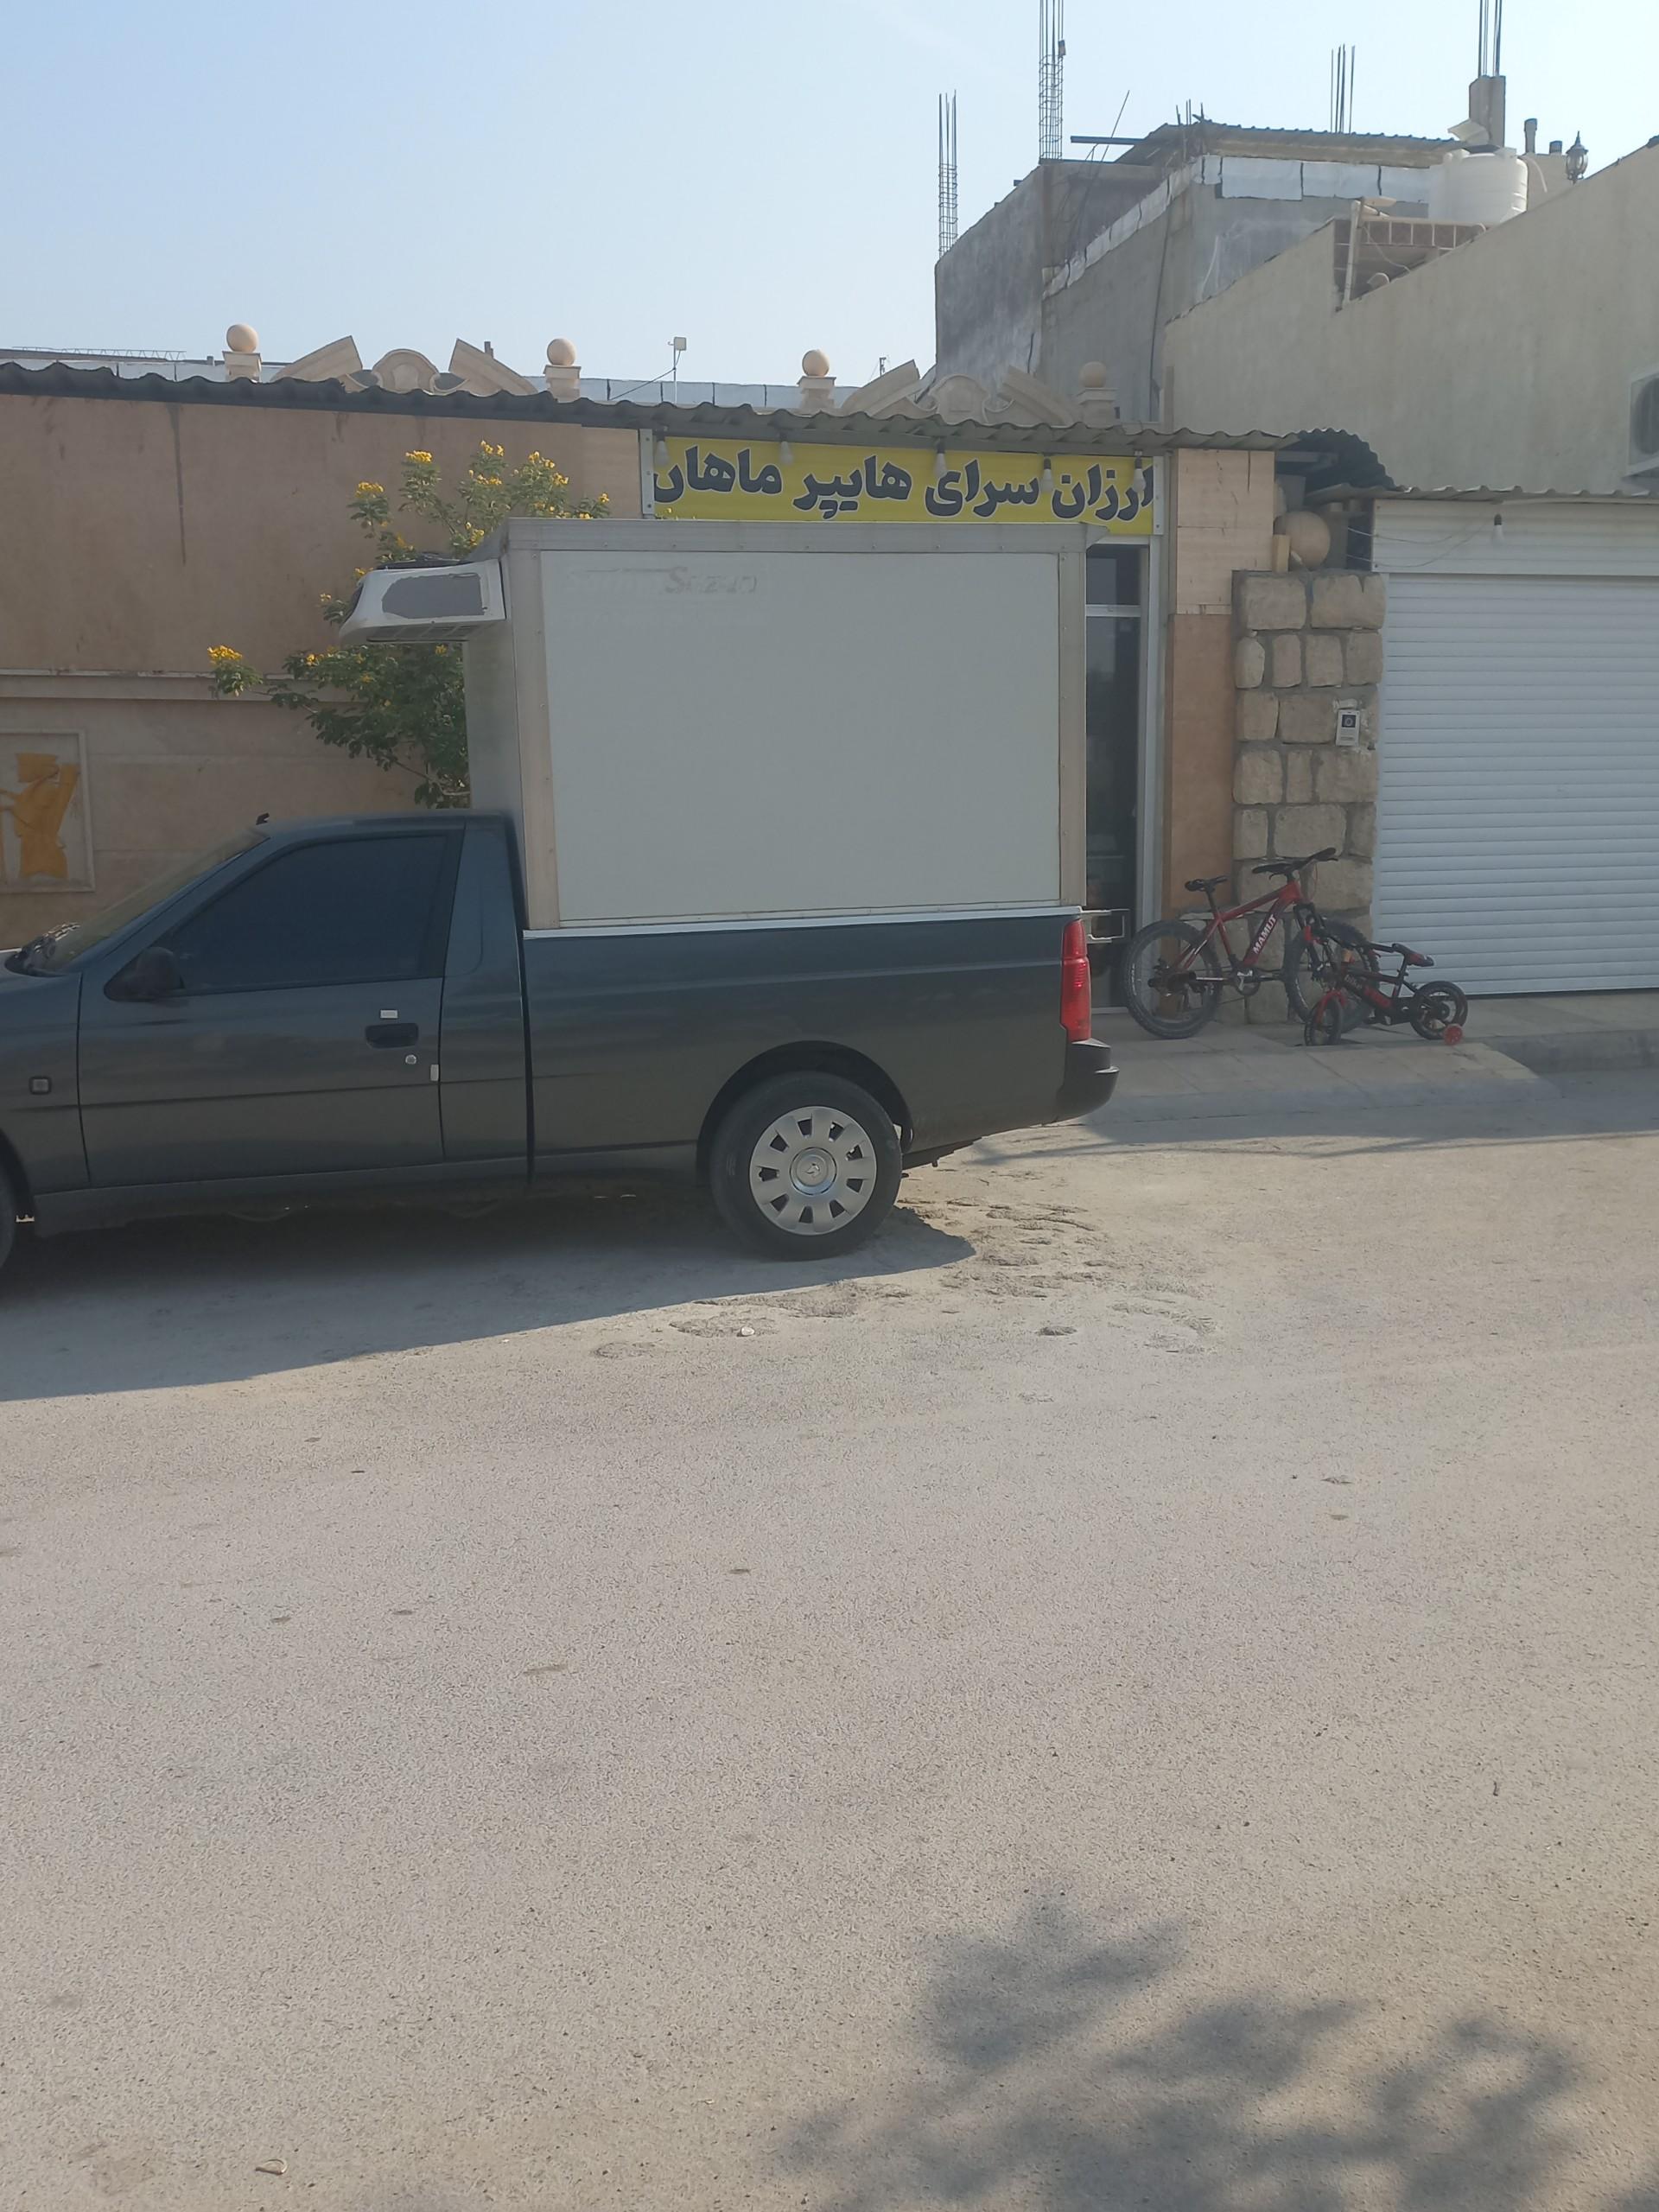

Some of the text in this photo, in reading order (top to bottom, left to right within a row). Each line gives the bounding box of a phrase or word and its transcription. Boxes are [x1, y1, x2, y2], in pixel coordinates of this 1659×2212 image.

[792, 454, 912, 519] هایپر
[925, 459, 1039, 517] سرای
[1052, 463, 1154, 520] ارزان
[1252, 914, 1277, 955] MAMUT
